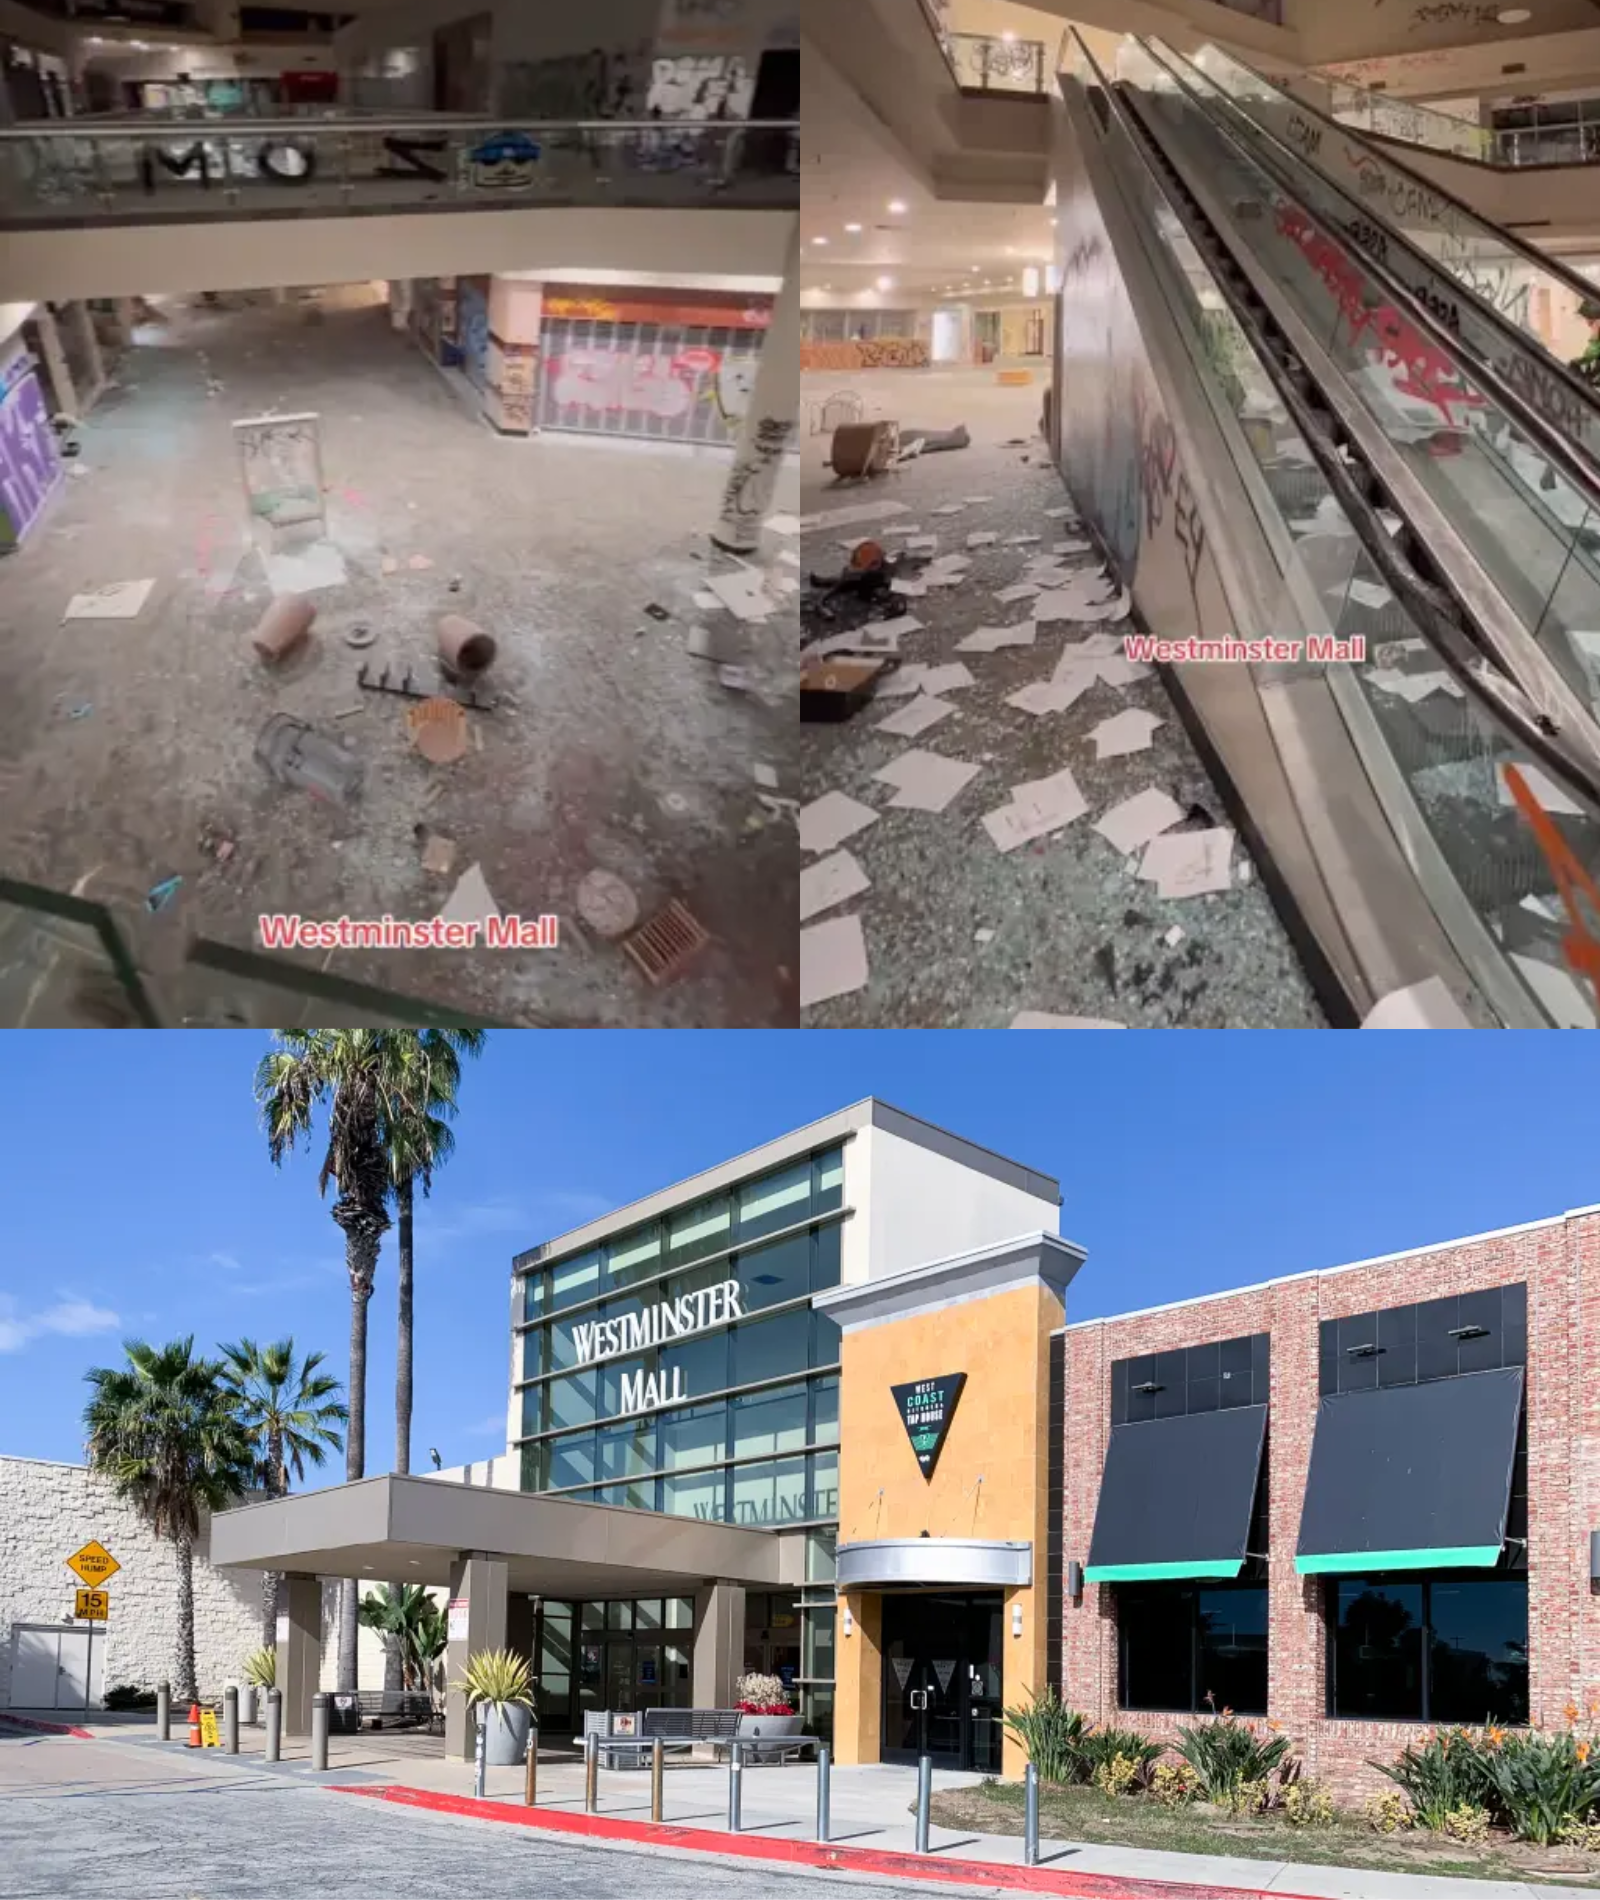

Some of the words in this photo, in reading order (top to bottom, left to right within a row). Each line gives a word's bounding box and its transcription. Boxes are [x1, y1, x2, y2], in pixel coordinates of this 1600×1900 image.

[571, 1279, 746, 1364] WESTMINSTER
[620, 1366, 688, 1415] MALL
[915, 1381, 935, 1394] WEST
[907, 1390, 945, 1407] COAST
[79, 1554, 109, 1564] SPEED
[80, 1564, 107, 1573] HUMP
[81, 1593, 102, 1608] 15
[80, 1608, 104, 1618] MPH
